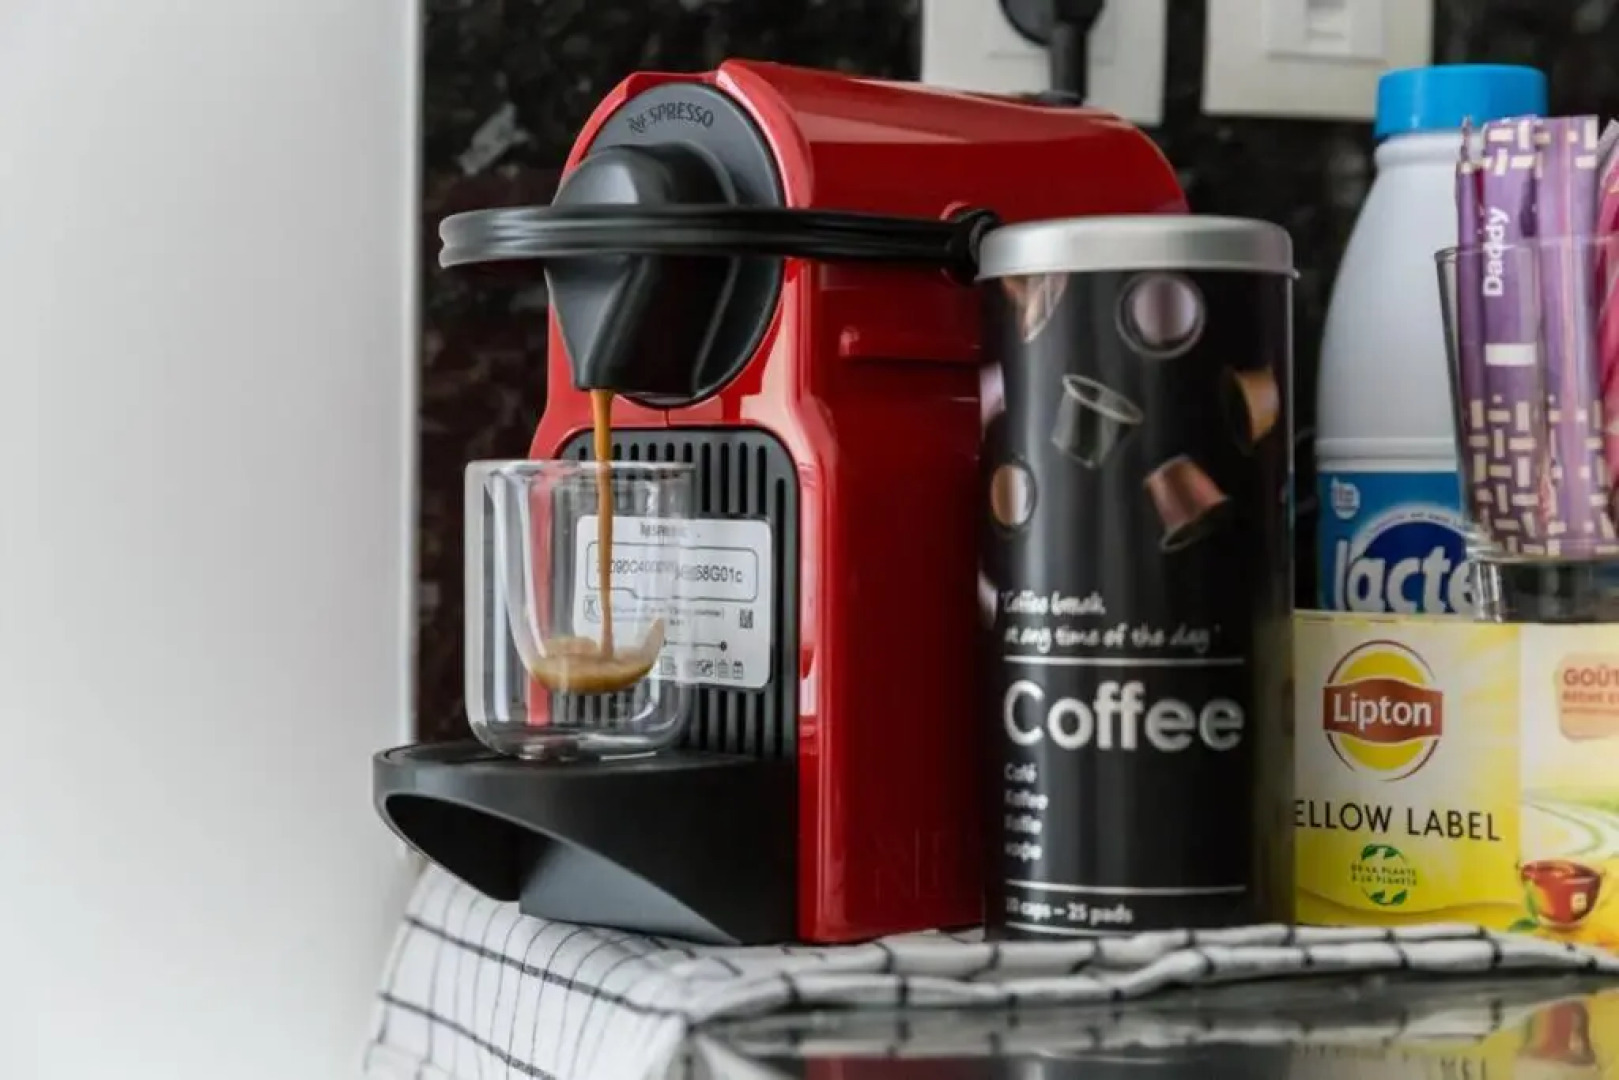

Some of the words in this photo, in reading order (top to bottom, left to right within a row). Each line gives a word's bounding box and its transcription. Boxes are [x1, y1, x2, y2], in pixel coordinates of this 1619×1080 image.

[1483, 206, 1510, 296] Daddy
[1020, 626, 1051, 653] any
[1055, 625, 1099, 647] time
[1102, 622, 1128, 648] of
[1131, 621, 1165, 647] the
[1004, 679, 1245, 751] Coffee
[1333, 692, 1433, 731] Lipton
[1294, 800, 1393, 834] ELLOW
[1407, 807, 1502, 842] LABEL
[1090, 903, 1133, 925] pads
